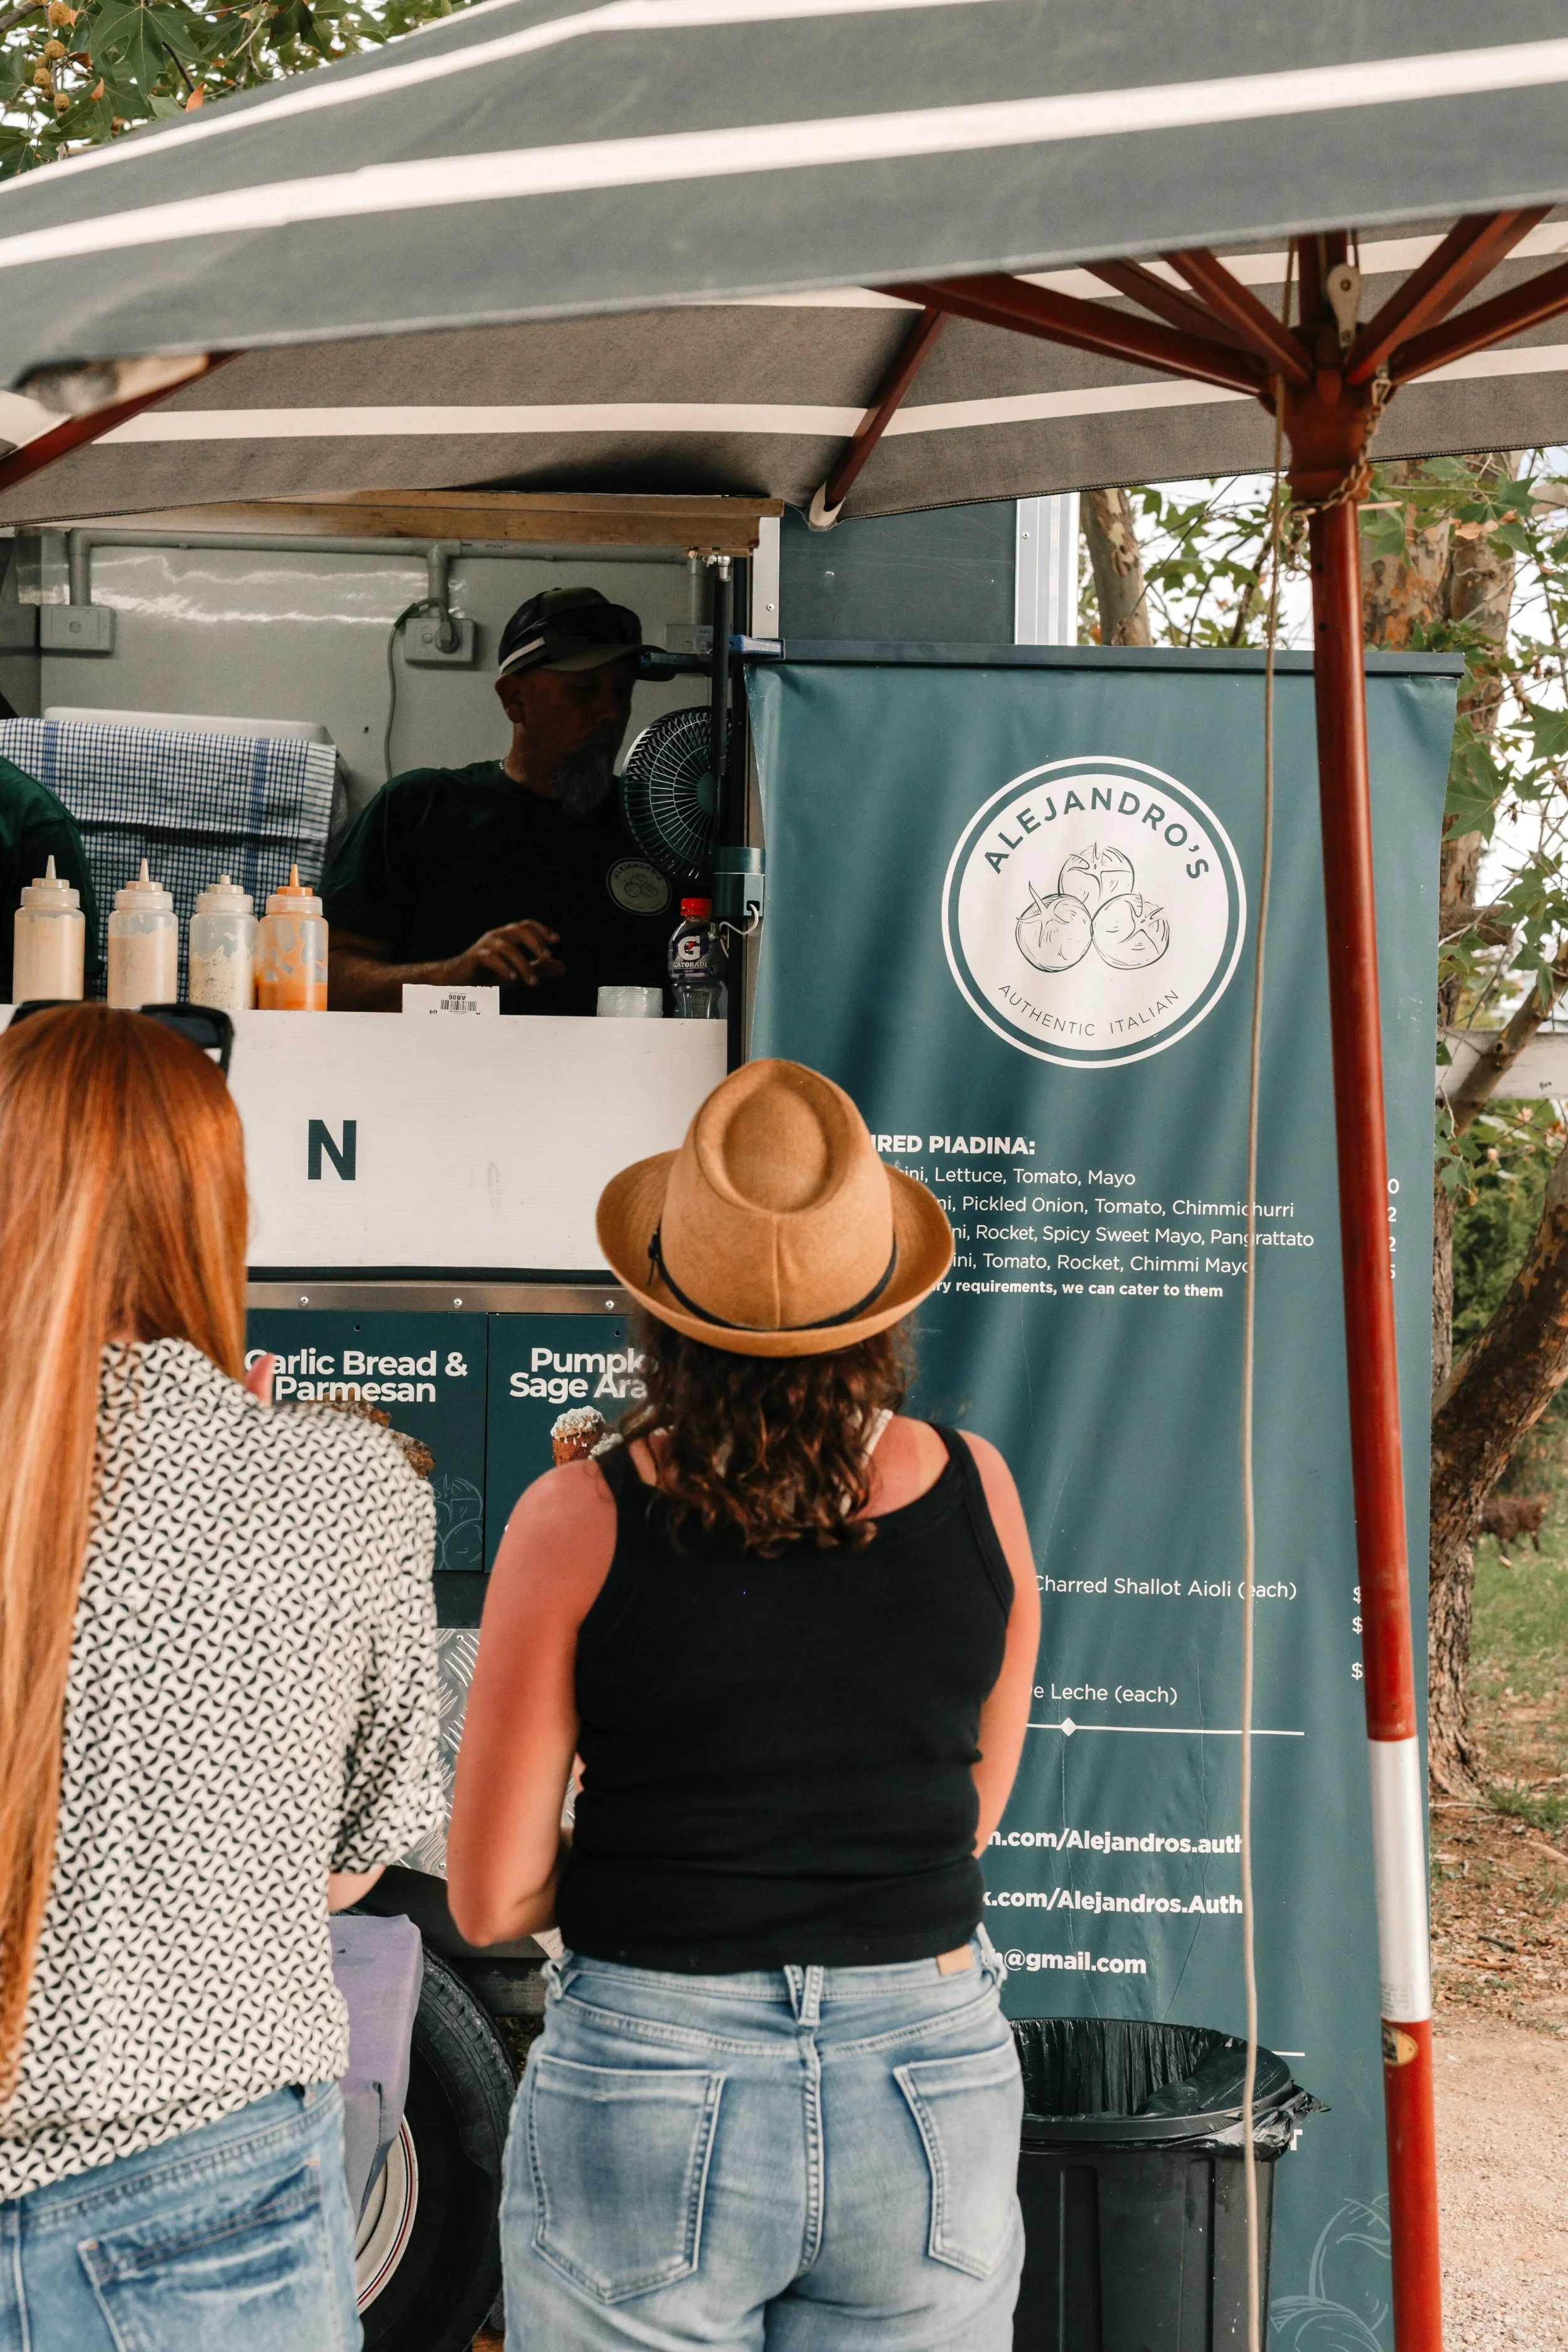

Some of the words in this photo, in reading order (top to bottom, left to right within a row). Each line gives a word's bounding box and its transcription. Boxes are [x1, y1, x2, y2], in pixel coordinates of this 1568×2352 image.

[985, 787, 1209, 879] ALEJANDRO'S
[678, 935, 700, 961] G
[998, 985, 1095, 1037] AUTHENTIC
[1110, 989, 1179, 1034] ITALIAN
[307, 1119, 357, 1181] N
[929, 1135, 1036, 1155] PIADINA:
[901, 1166, 928, 1183] ini,
[935, 1167, 1007, 1185] Lettuce,
[1013, 1168, 1081, 1187] Tomato,
[1088, 1170, 1136, 1188] Mayo
[933, 1195, 956, 1212] ni,
[963, 1195, 1027, 1212] Pickled
[1032, 1197, 1088, 1215] Onion,
[1094, 1198, 1166, 1216] Tomato,
[1172, 1199, 1294, 1217] Chimmichurri
[948, 1224, 971, 1241] ni,
[977, 1224, 1038, 1242] Rocket,
[1042, 1226, 1091, 1244] Spicy
[1096, 1226, 1150, 1242] Sweet
[1155, 1228, 1205, 1246] Mayo,
[1210, 1229, 1315, 1247] Pangrattato
[983, 1253, 1051, 1271] Tomato,
[1057, 1254, 1124, 1273] Rocket,
[1130, 1256, 1199, 1272] Chimmi
[934, 1280, 951, 1293] ry
[956, 1279, 1057, 1296] requirements,
[1061, 1284, 1084, 1294] we
[1088, 1284, 1115, 1295] can
[1119, 1283, 1160, 1296] cater
[1163, 1284, 1180, 1296] to
[1184, 1283, 1223, 1297] them
[244, 1348, 336, 1375] Garlic
[343, 1350, 437, 1376] Bread
[445, 1352, 468, 1377] &
[276, 1376, 437, 1402] Parmesan
[509, 1371, 589, 1404] Sage
[1035, 1576, 1108, 1594] Charred
[1114, 1577, 1181, 1596] Shallot
[1187, 1580, 1231, 1597] Aioli
[1237, 1581, 1297, 1601] (each)
[1051, 1683, 1108, 1701] Leche
[1115, 1685, 1177, 1706] (each)
